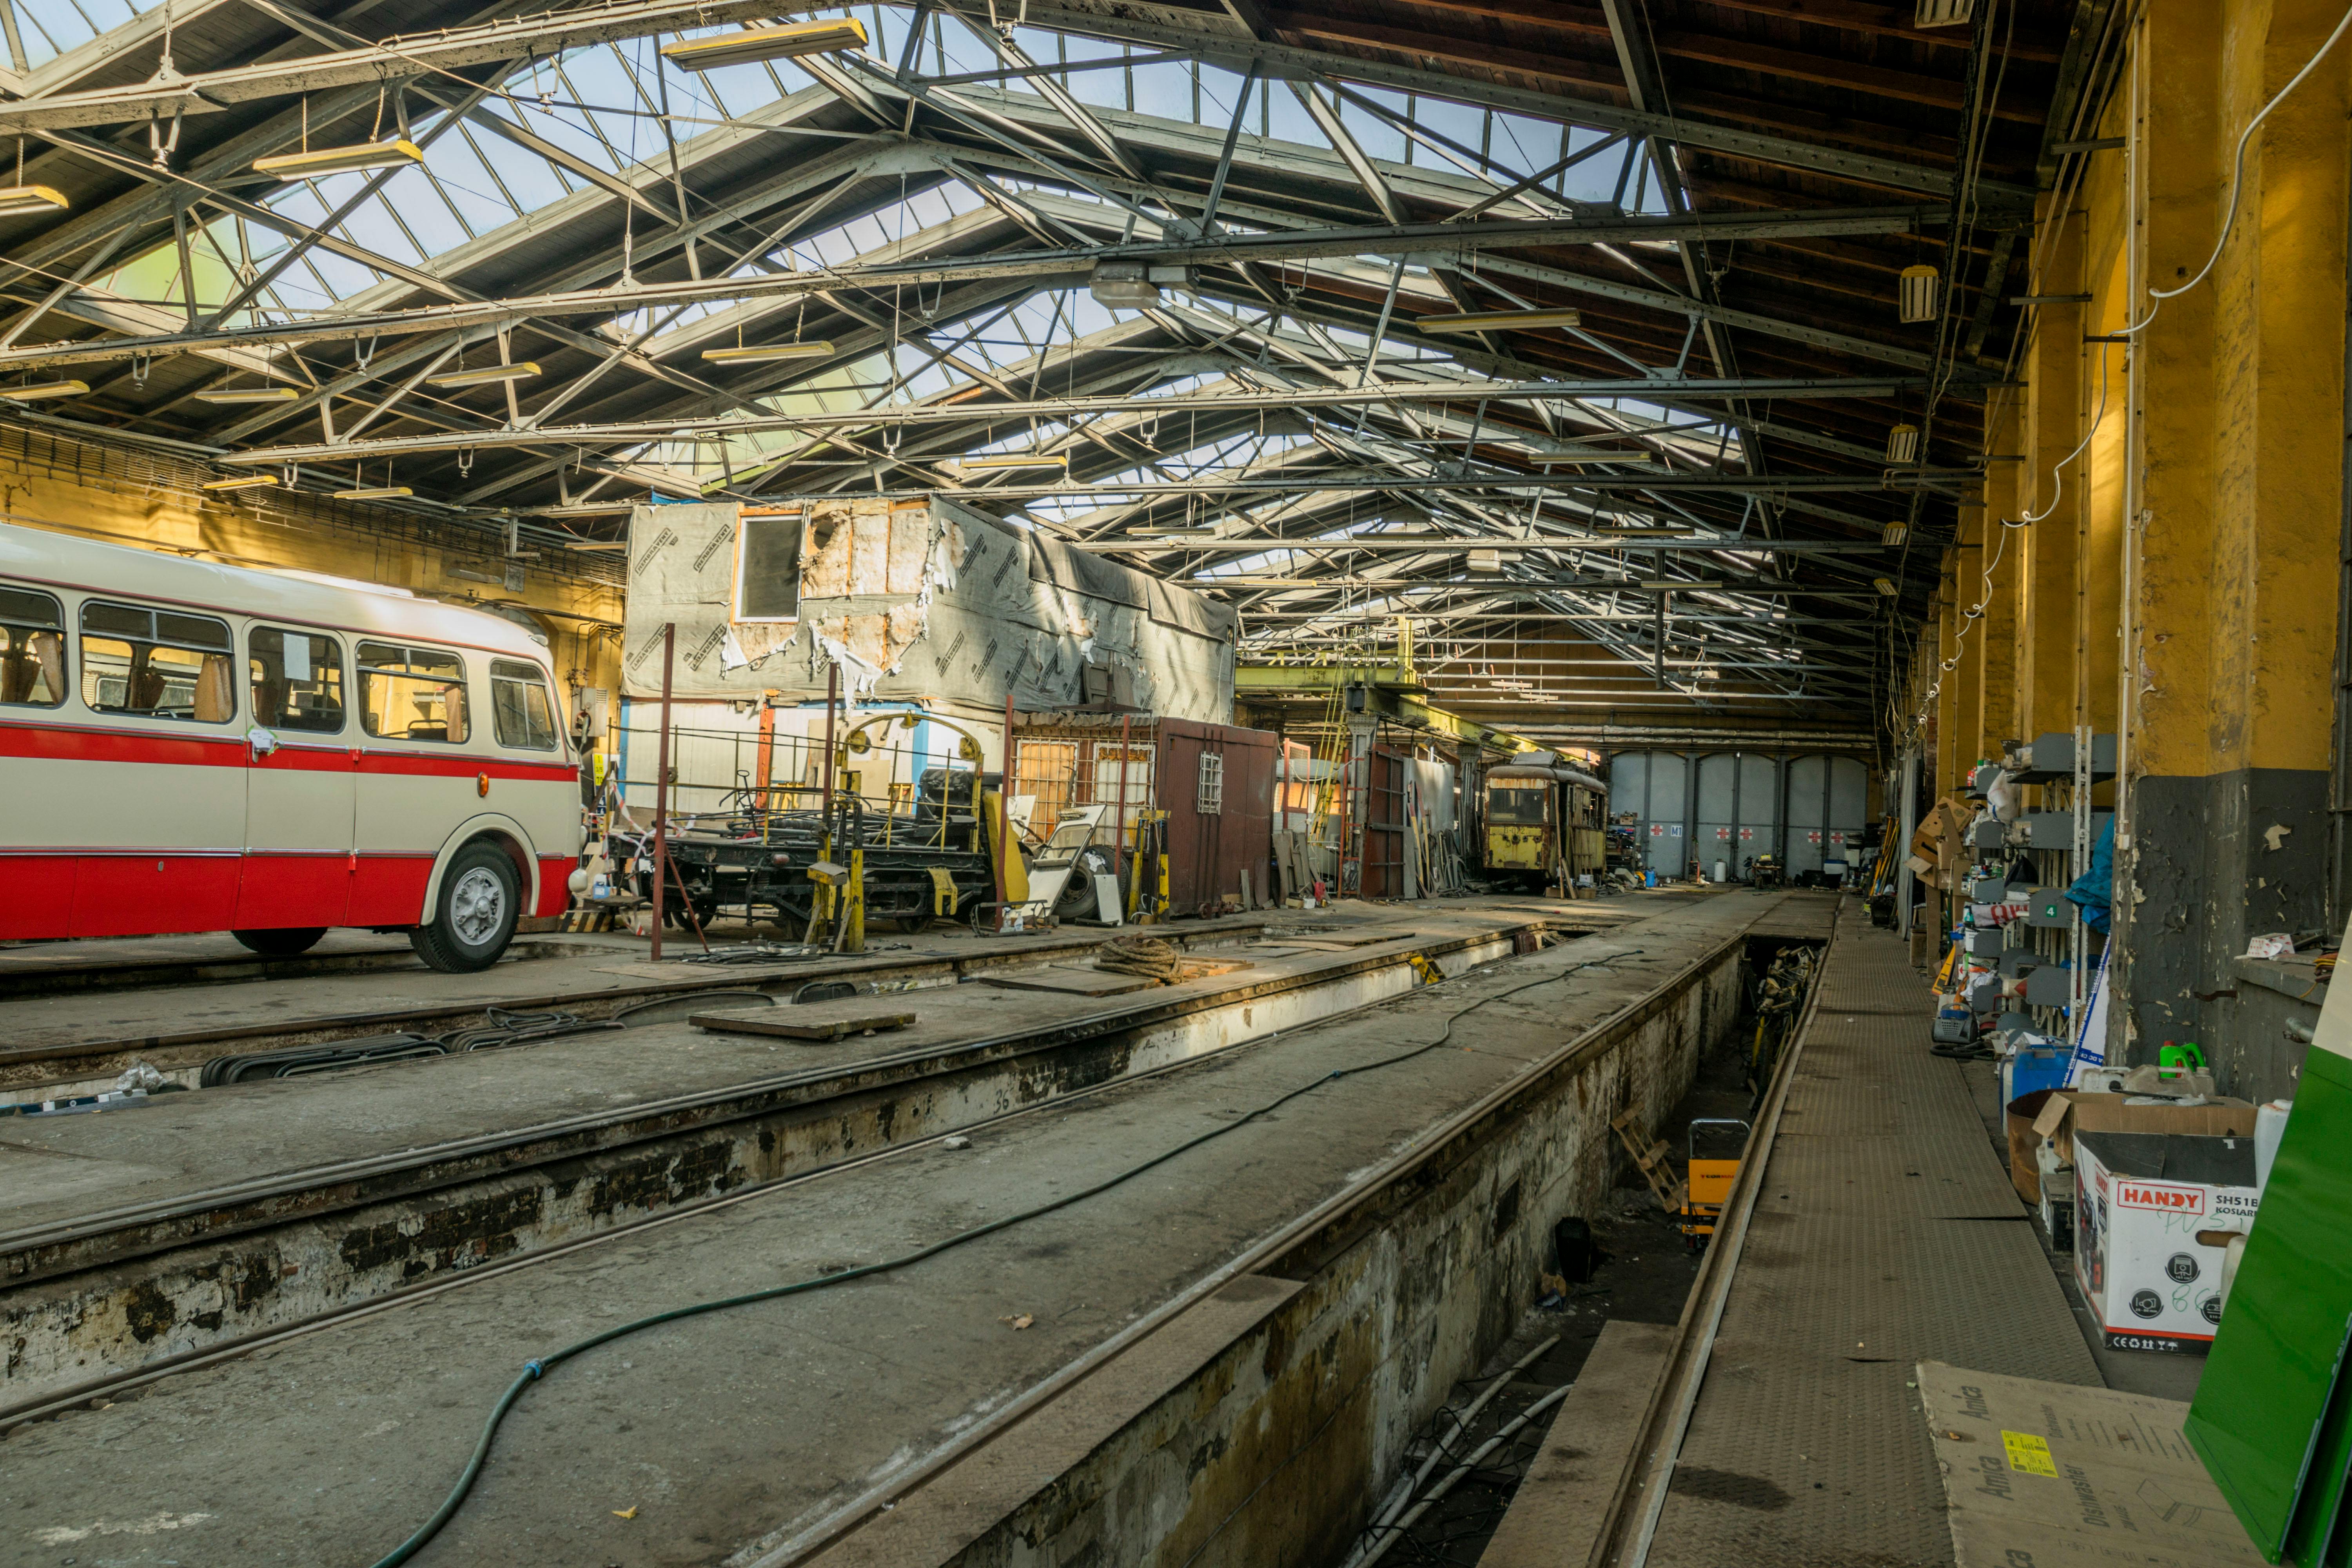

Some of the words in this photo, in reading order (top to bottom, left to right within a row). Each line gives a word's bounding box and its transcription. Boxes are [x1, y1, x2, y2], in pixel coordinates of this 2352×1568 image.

[637, 532, 669, 572] MEMBRAVENT
[696, 529, 728, 569] MEMBRAVENT
[1671, 827, 1682, 836] M1
[2047, 907, 2054, 916] 4
[2125, 1188, 2199, 1209] HANDY
[2216, 1195, 2258, 1207] SH51B
[1951, 1386, 1991, 1422] Amica
[1968, 1455, 2014, 1501] Amica
[2063, 1463, 2111, 1528] Dishwasher
